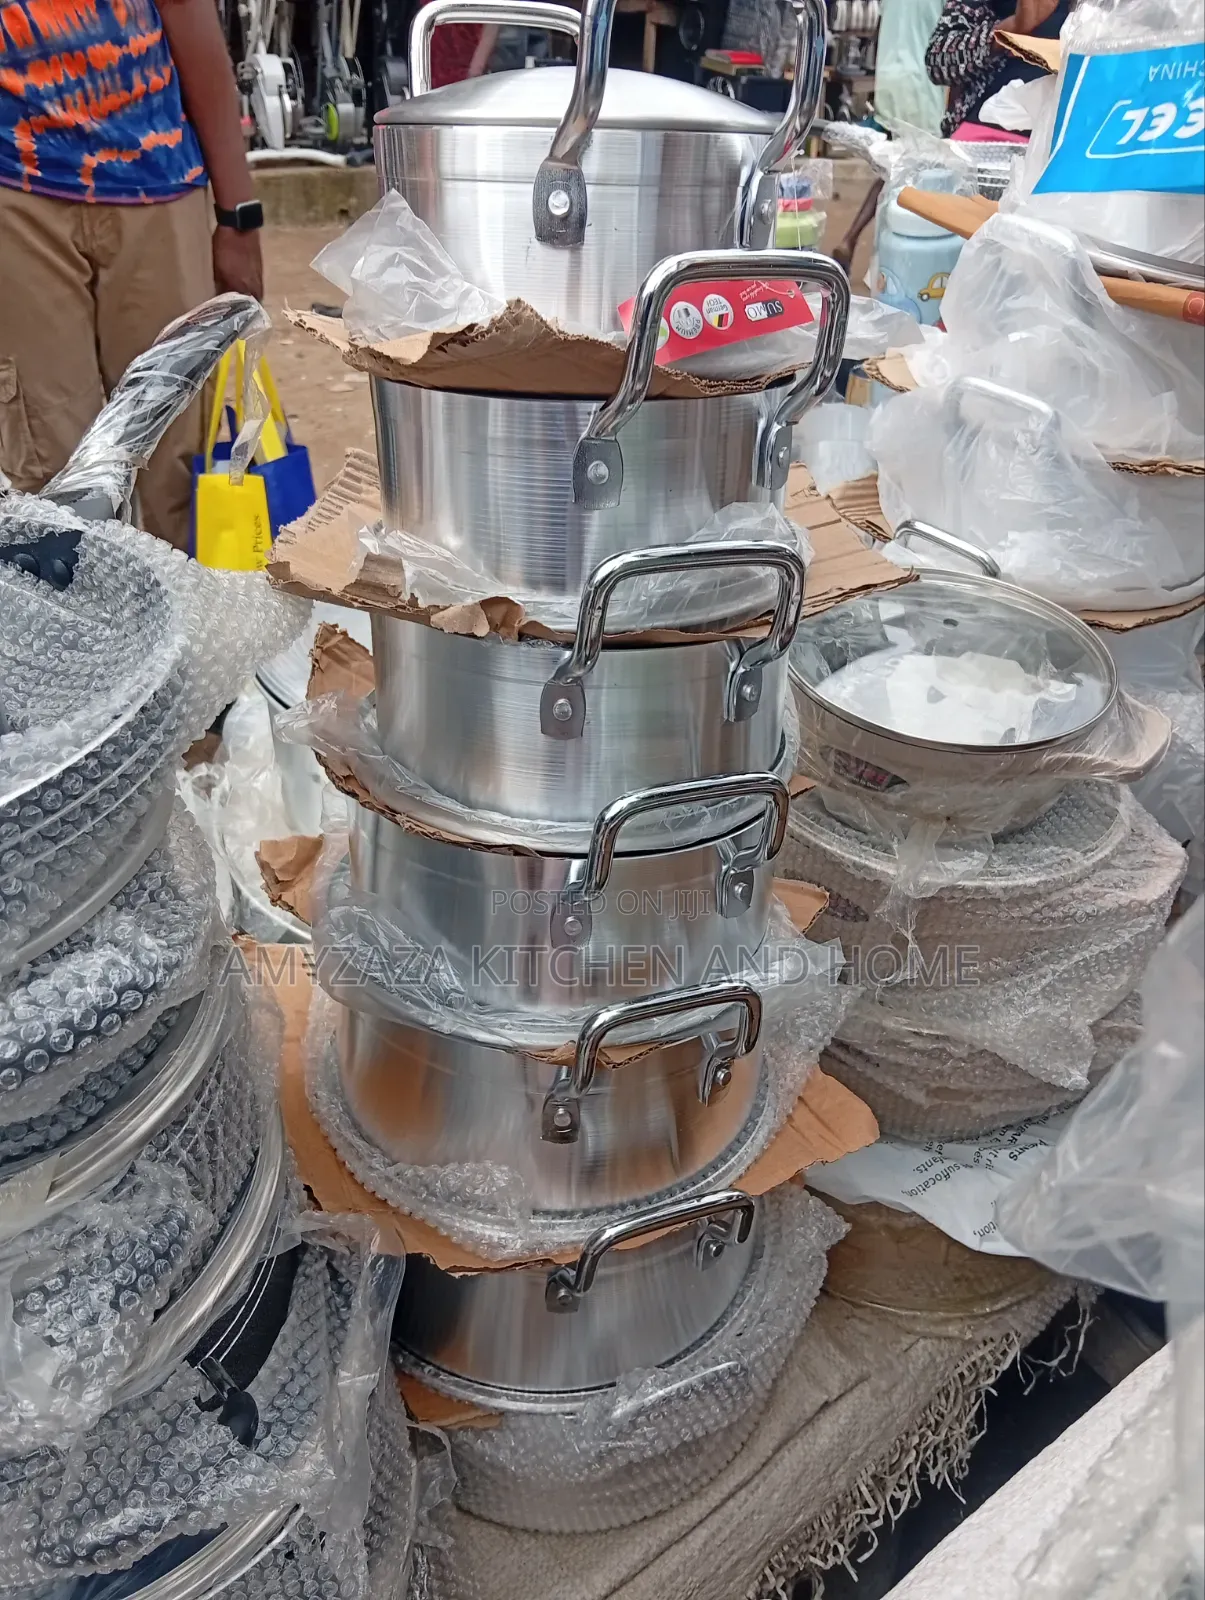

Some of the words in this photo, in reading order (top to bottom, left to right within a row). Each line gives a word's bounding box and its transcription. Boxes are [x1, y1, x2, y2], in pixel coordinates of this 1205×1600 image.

[706, 297, 722, 308] TECH
[706, 303, 729, 315] German
[746, 300, 783, 319] SUMO
[675, 318, 701, 337] PREMIUM
